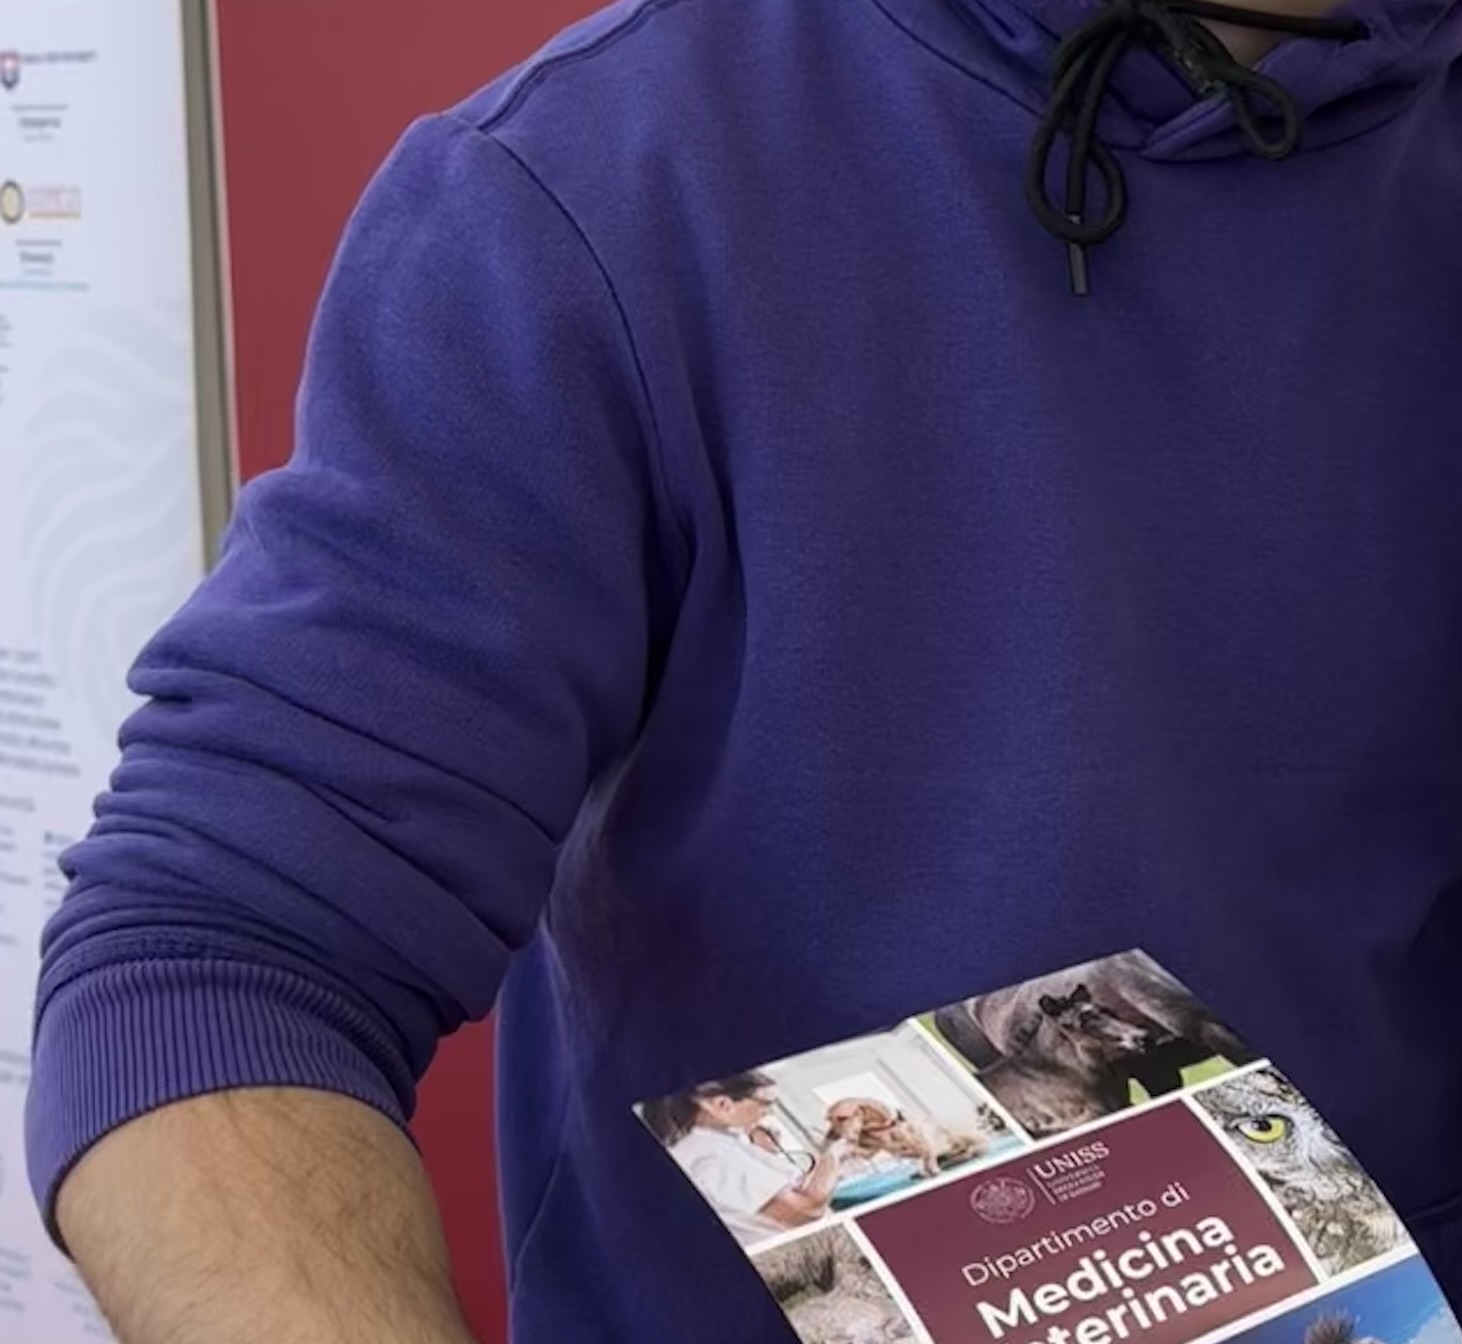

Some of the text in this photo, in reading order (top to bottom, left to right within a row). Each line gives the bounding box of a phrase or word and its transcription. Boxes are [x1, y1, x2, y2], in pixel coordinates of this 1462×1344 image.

[1033, 1140, 1111, 1180] UNISS
[961, 1199, 1157, 1286] Dipartimento
[1160, 1181, 1191, 1208] di
[975, 1215, 1235, 1340] Medicina
